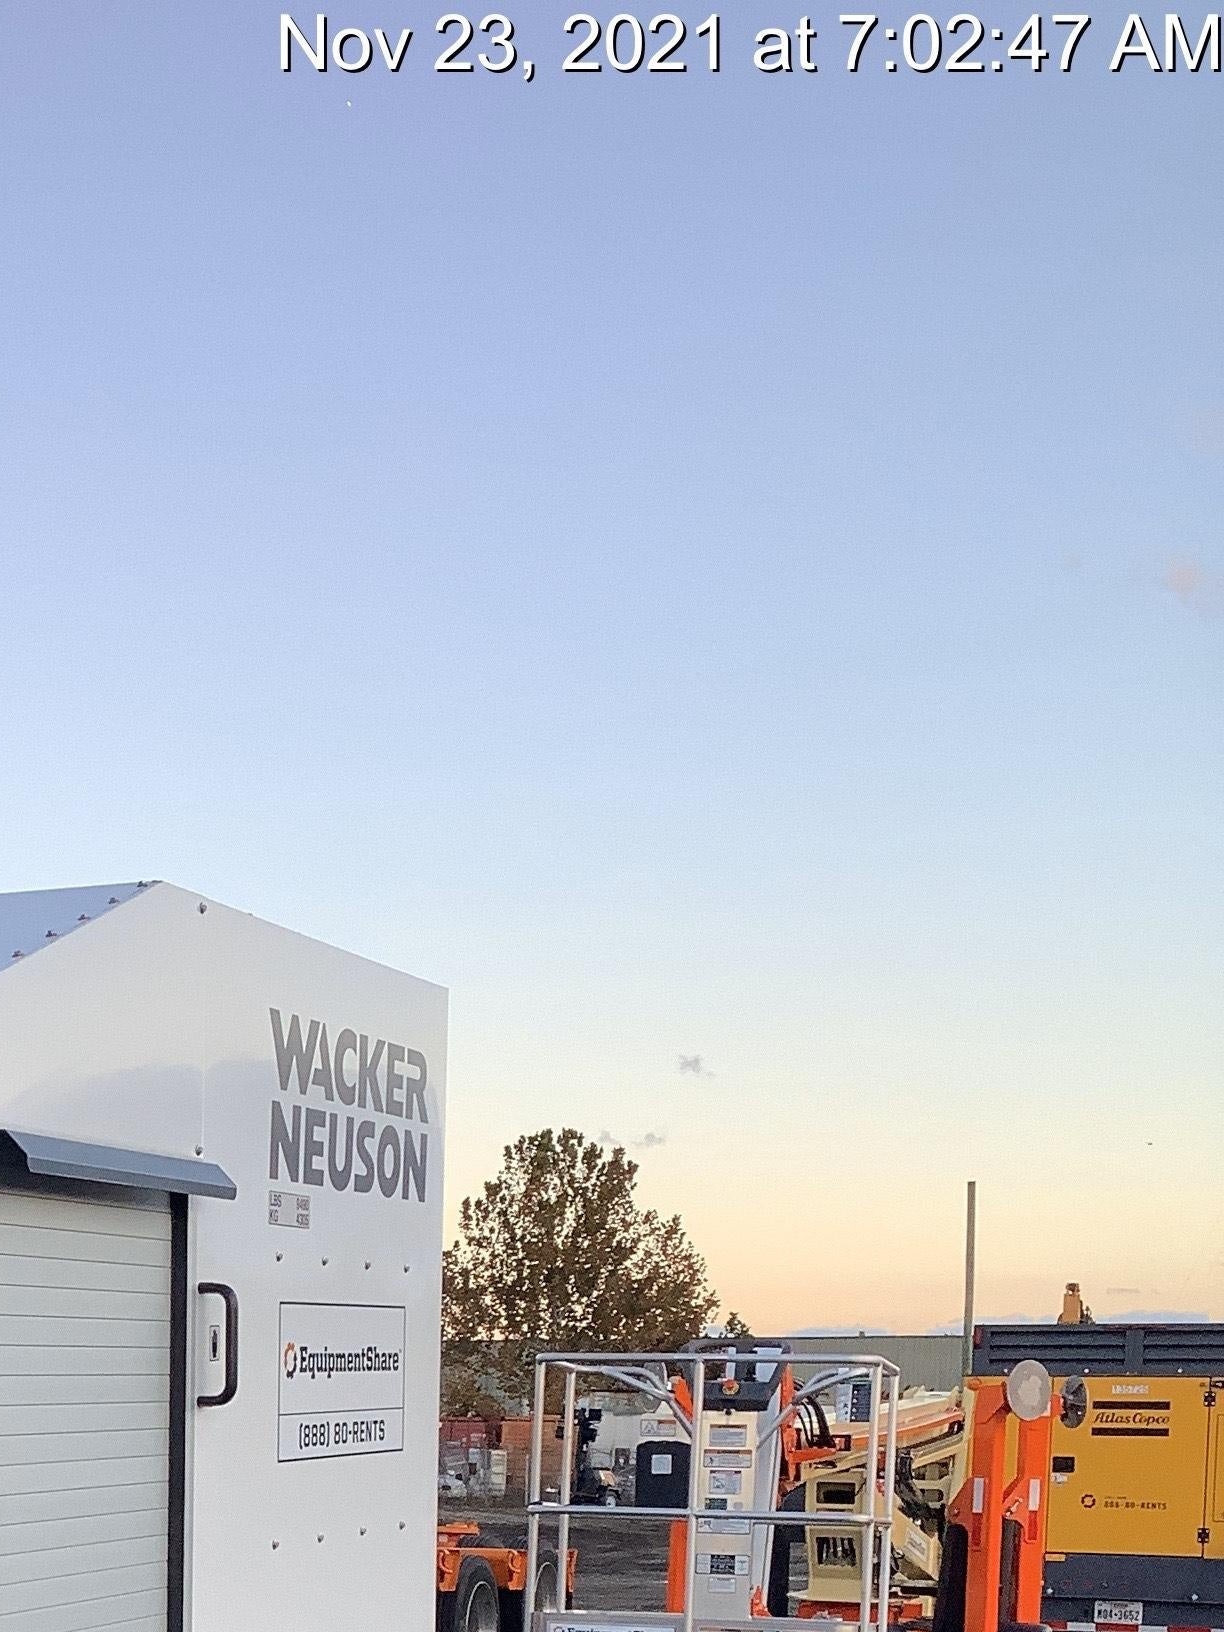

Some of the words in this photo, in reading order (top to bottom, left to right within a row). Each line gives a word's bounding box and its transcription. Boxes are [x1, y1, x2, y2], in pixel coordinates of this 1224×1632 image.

[269, 1008, 429, 1124] WACKER
[269, 1100, 428, 1203] NEUSON
[299, 1346, 400, 1379] EquipmentShare
[299, 1421, 330, 1450] (888)
